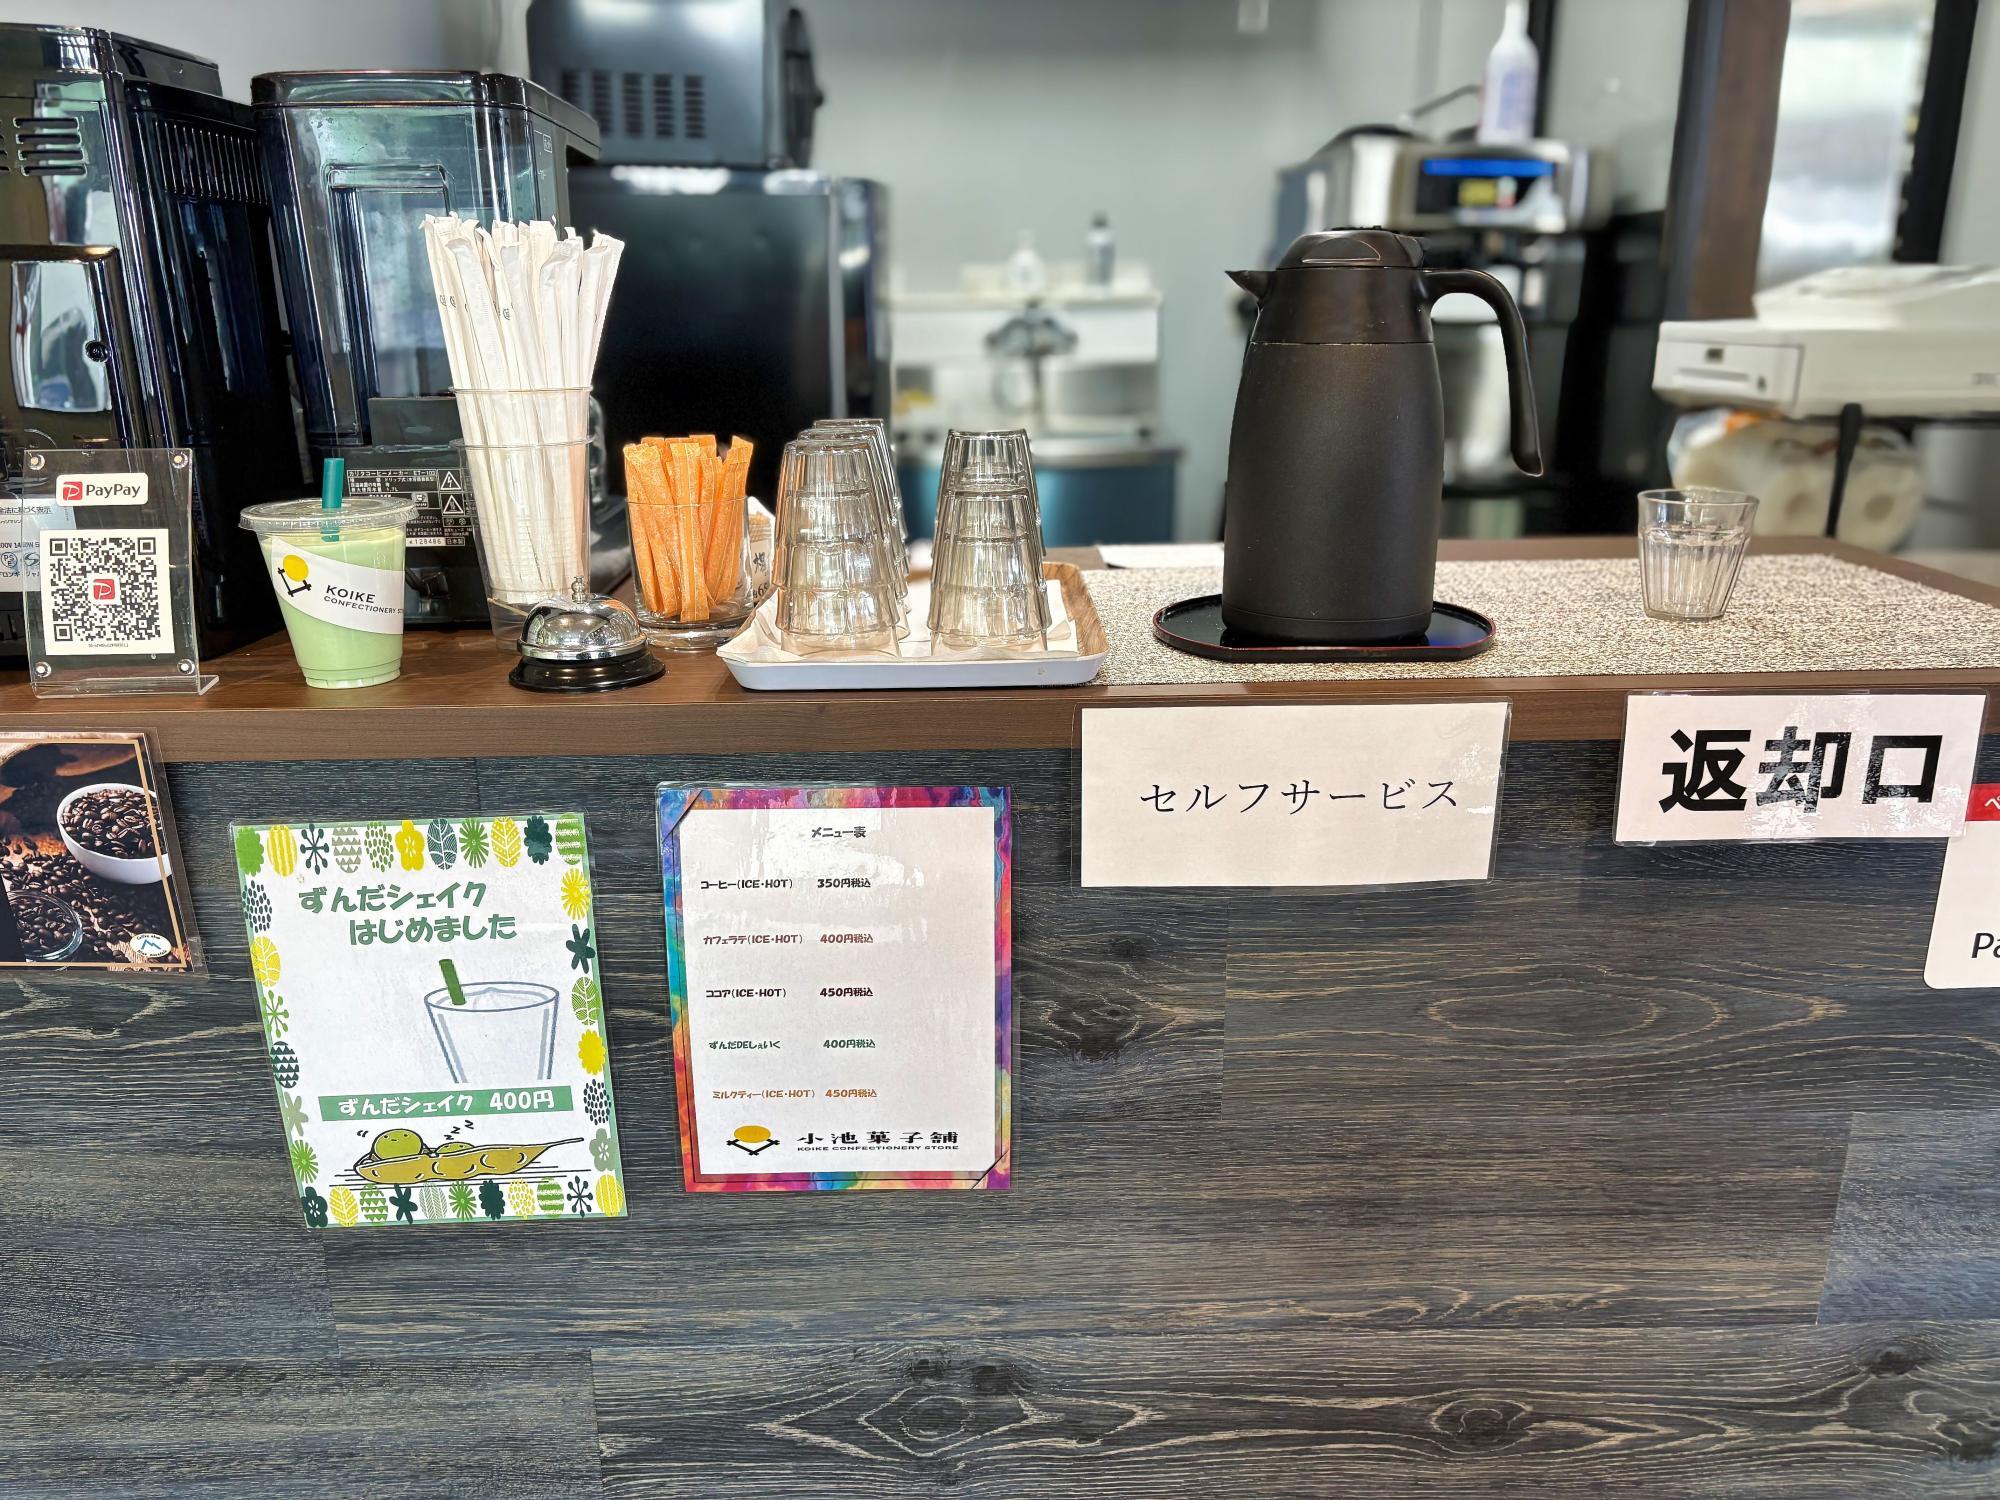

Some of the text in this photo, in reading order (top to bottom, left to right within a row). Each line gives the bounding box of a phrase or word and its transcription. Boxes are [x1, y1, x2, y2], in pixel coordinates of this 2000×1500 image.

[86, 483, 141, 499] PayPay
[326, 584, 376, 603] KOIKE
[323, 595, 397, 614] CONFECTIONERY
[1659, 726, 1943, 813] 返却口
[1140, 778, 1457, 815] セルフサービス
[811, 825, 867, 839] メニュー表
[816, 877, 872, 889] 350円税込
[298, 881, 488, 914] ずんだシェイク
[350, 913, 518, 946] はじめました
[819, 933, 874, 945] 400円税込
[819, 987, 874, 998] 450円税込
[708, 1039, 876, 1050] ずんだDEしぇいく 400円税込
[825, 1088, 878, 1098] 450円税込
[338, 1090, 555, 1117] ずんだシェイク 400円
[796, 1130, 959, 1145] 小池菓子舗
